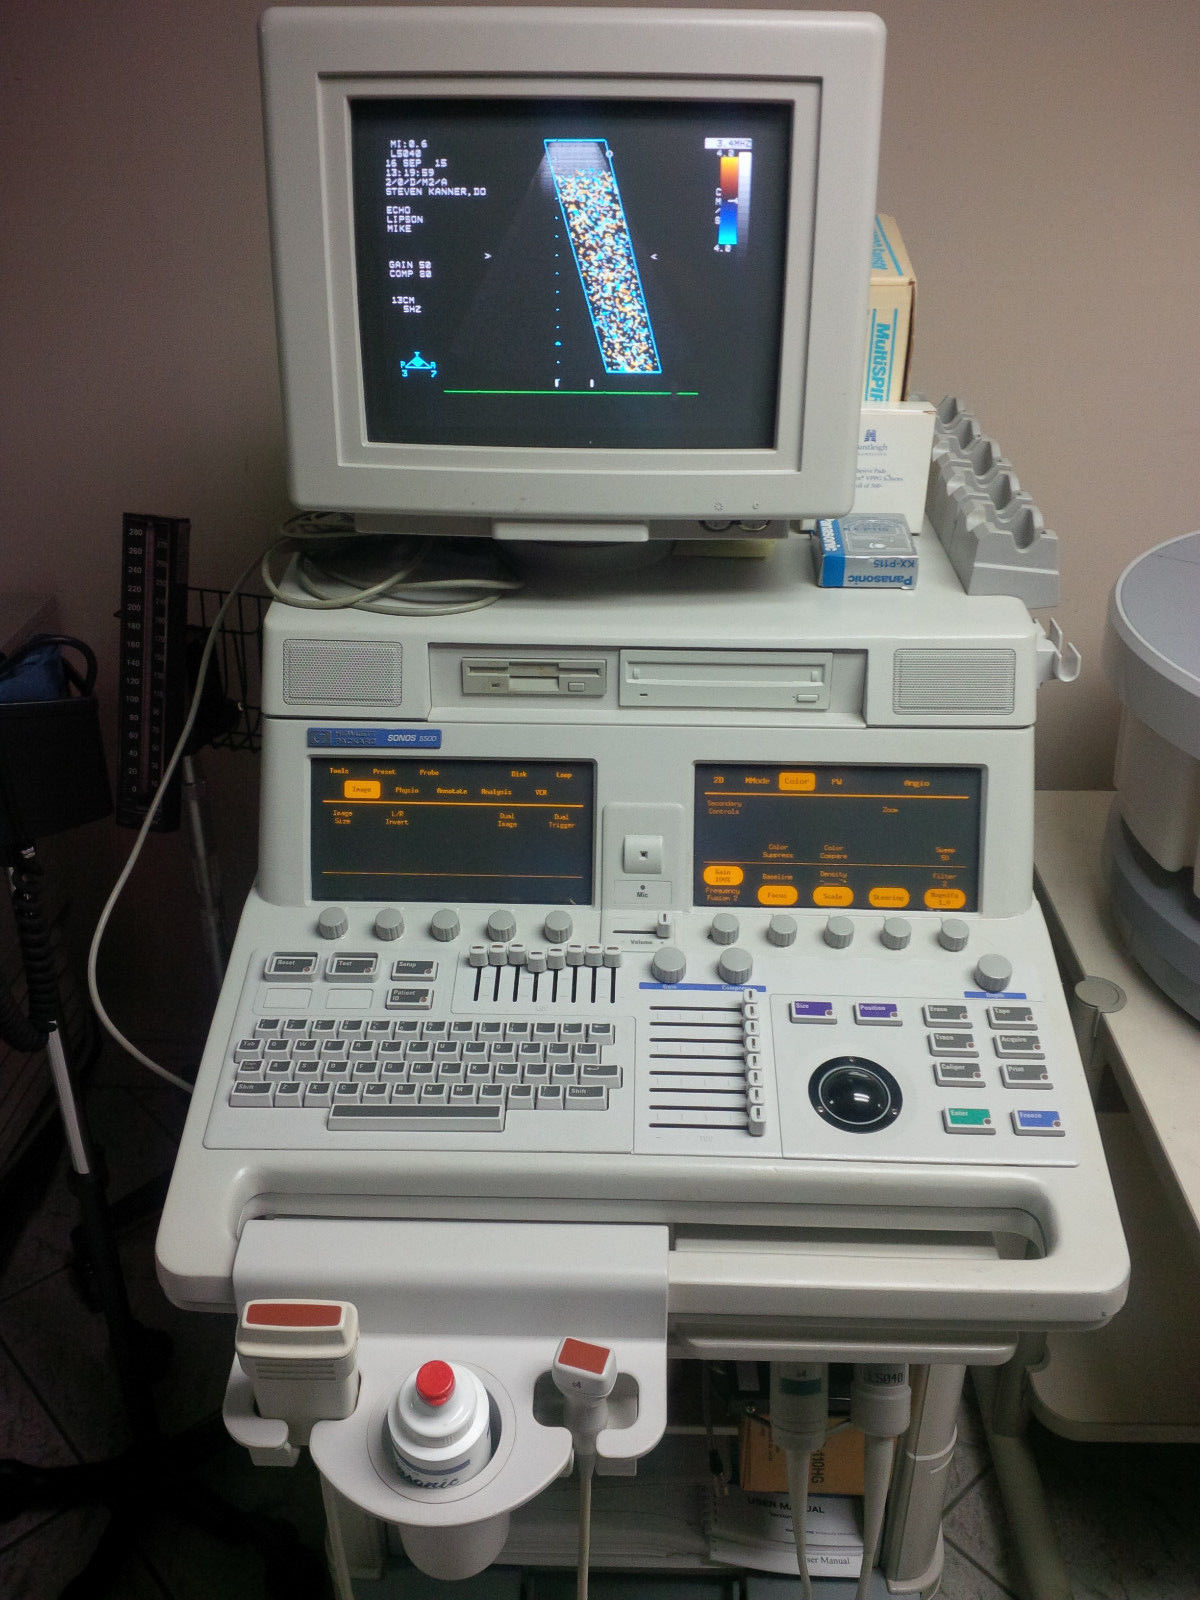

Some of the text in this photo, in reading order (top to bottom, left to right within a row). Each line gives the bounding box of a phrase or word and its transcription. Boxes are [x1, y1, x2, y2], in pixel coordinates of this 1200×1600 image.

[390, 149, 422, 158] L5040
[386, 159, 448, 167] 16 SEP 15
[386, 168, 435, 177] 13:19:59
[386, 187, 423, 196] STEVEN
[386, 206, 411, 215] ECHO
[386, 215, 424, 224] LIPSON
[387, 224, 412, 233] MIKE
[389, 260, 413, 269] GAIN
[389, 270, 413, 278] COMP
[391, 296, 415, 304] 13CM
[873, 559, 915, 568] KX-P115
[847, 575, 913, 586] Panasonic
[127, 585, 141, 593] 220
[127, 604, 141, 612] 200
[126, 678, 140, 686] 120
[387, 734, 417, 742] SONOS
[330, 767, 349, 775] Tools
[511, 770, 527, 778] Disk
[556, 771, 573, 779] Loop
[713, 776, 725, 784] 2D
[784, 777, 809, 785] Color
[904, 779, 931, 788] Angio
[395, 786, 419, 795] Physio
[437, 787, 468, 795] Annotate
[481, 788, 512, 796] Analysis
[707, 799, 742, 808] Secondary
[335, 817, 351, 825] Size
[549, 821, 575, 830] Trigger
[768, 843, 789, 851] Color
[762, 851, 794, 859] Suppress
[820, 870, 848, 878] Density
[705, 887, 740, 895] Frequency
[1001, 1036, 1027, 1044] Acquire
[941, 1063, 966, 1071] Caliper
[820, 1556, 850, 1565] Manual
